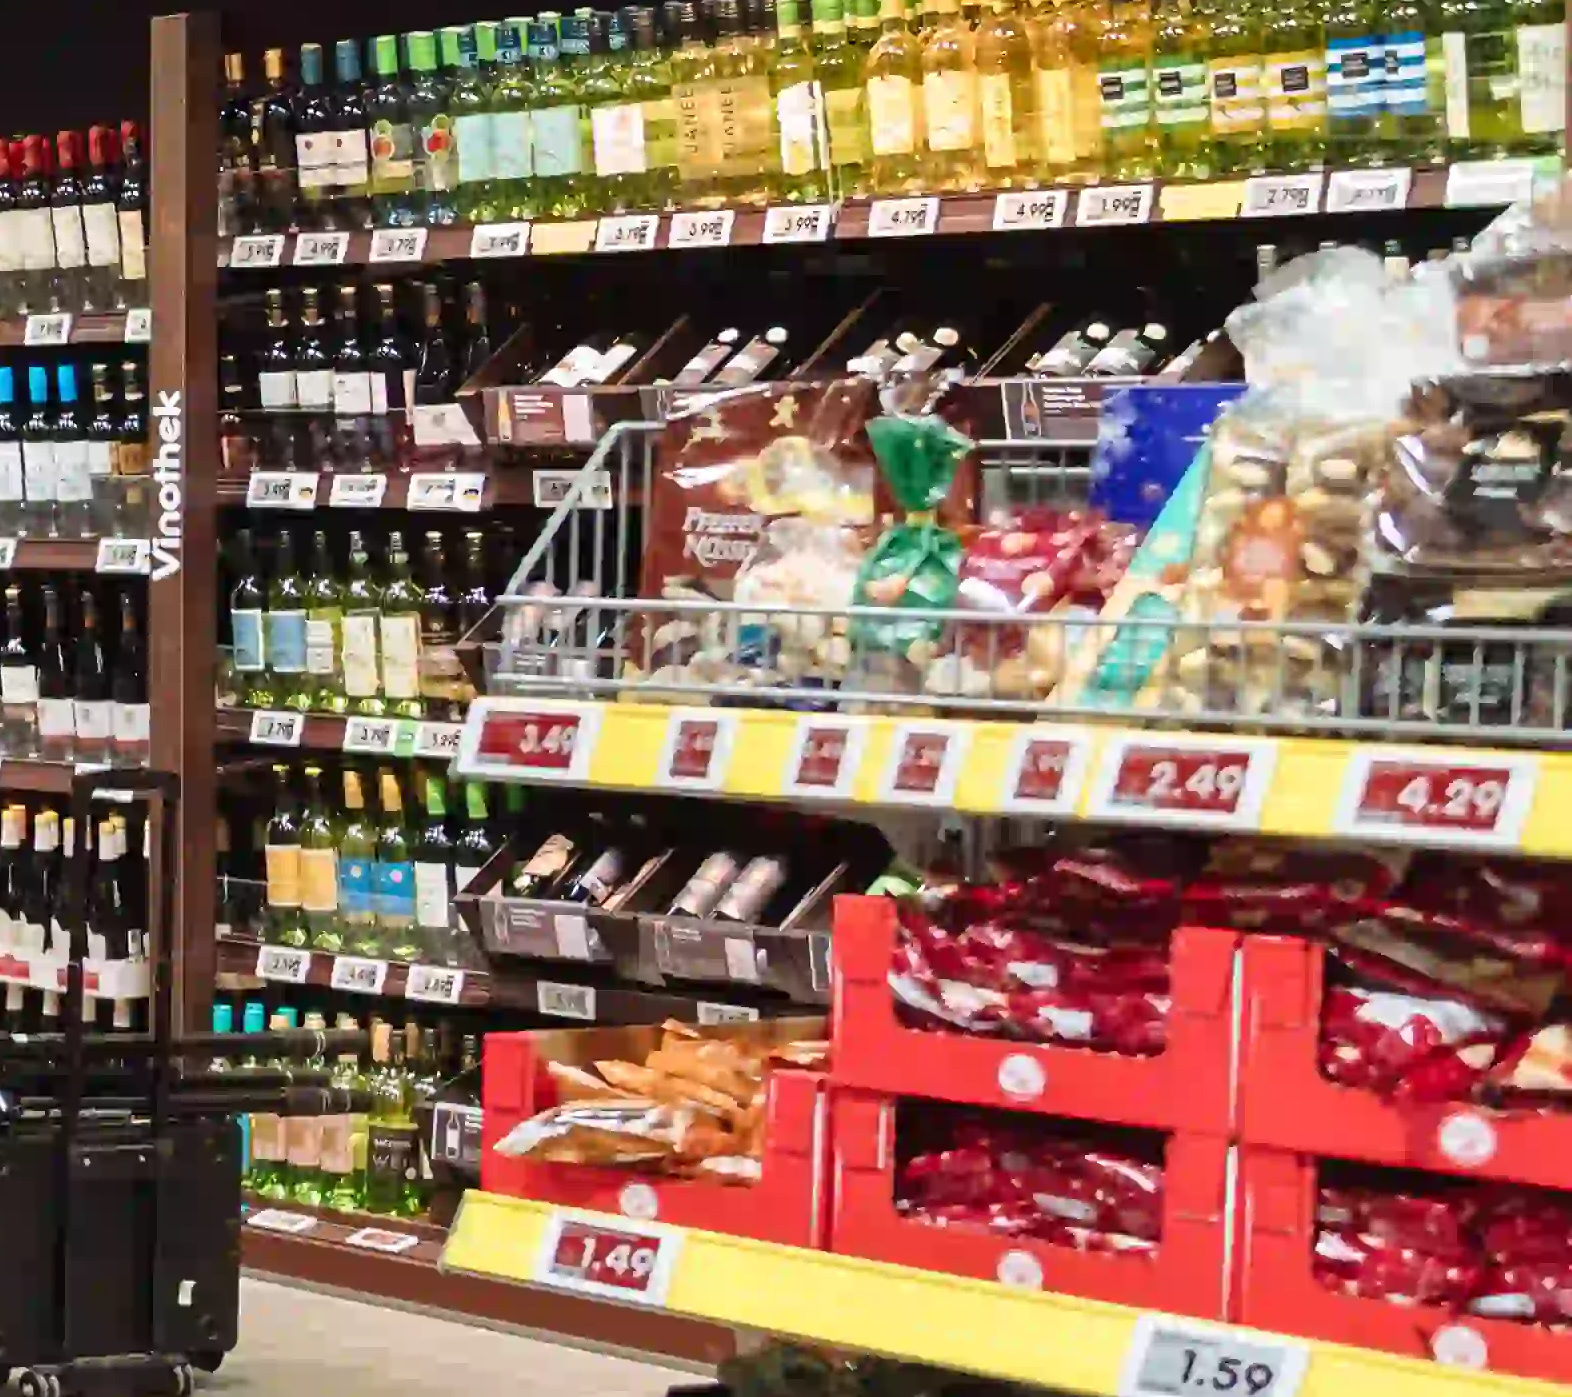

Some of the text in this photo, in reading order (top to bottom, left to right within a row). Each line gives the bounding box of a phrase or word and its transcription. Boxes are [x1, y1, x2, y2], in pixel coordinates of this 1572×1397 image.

[151, 391, 183, 579] Vinothek
[1147, 763, 1246, 801] 2.49
[1397, 777, 1502, 819] 4.29
[579, 1236, 655, 1281] 1.49
[1179, 1348, 1274, 1396] 1.59
